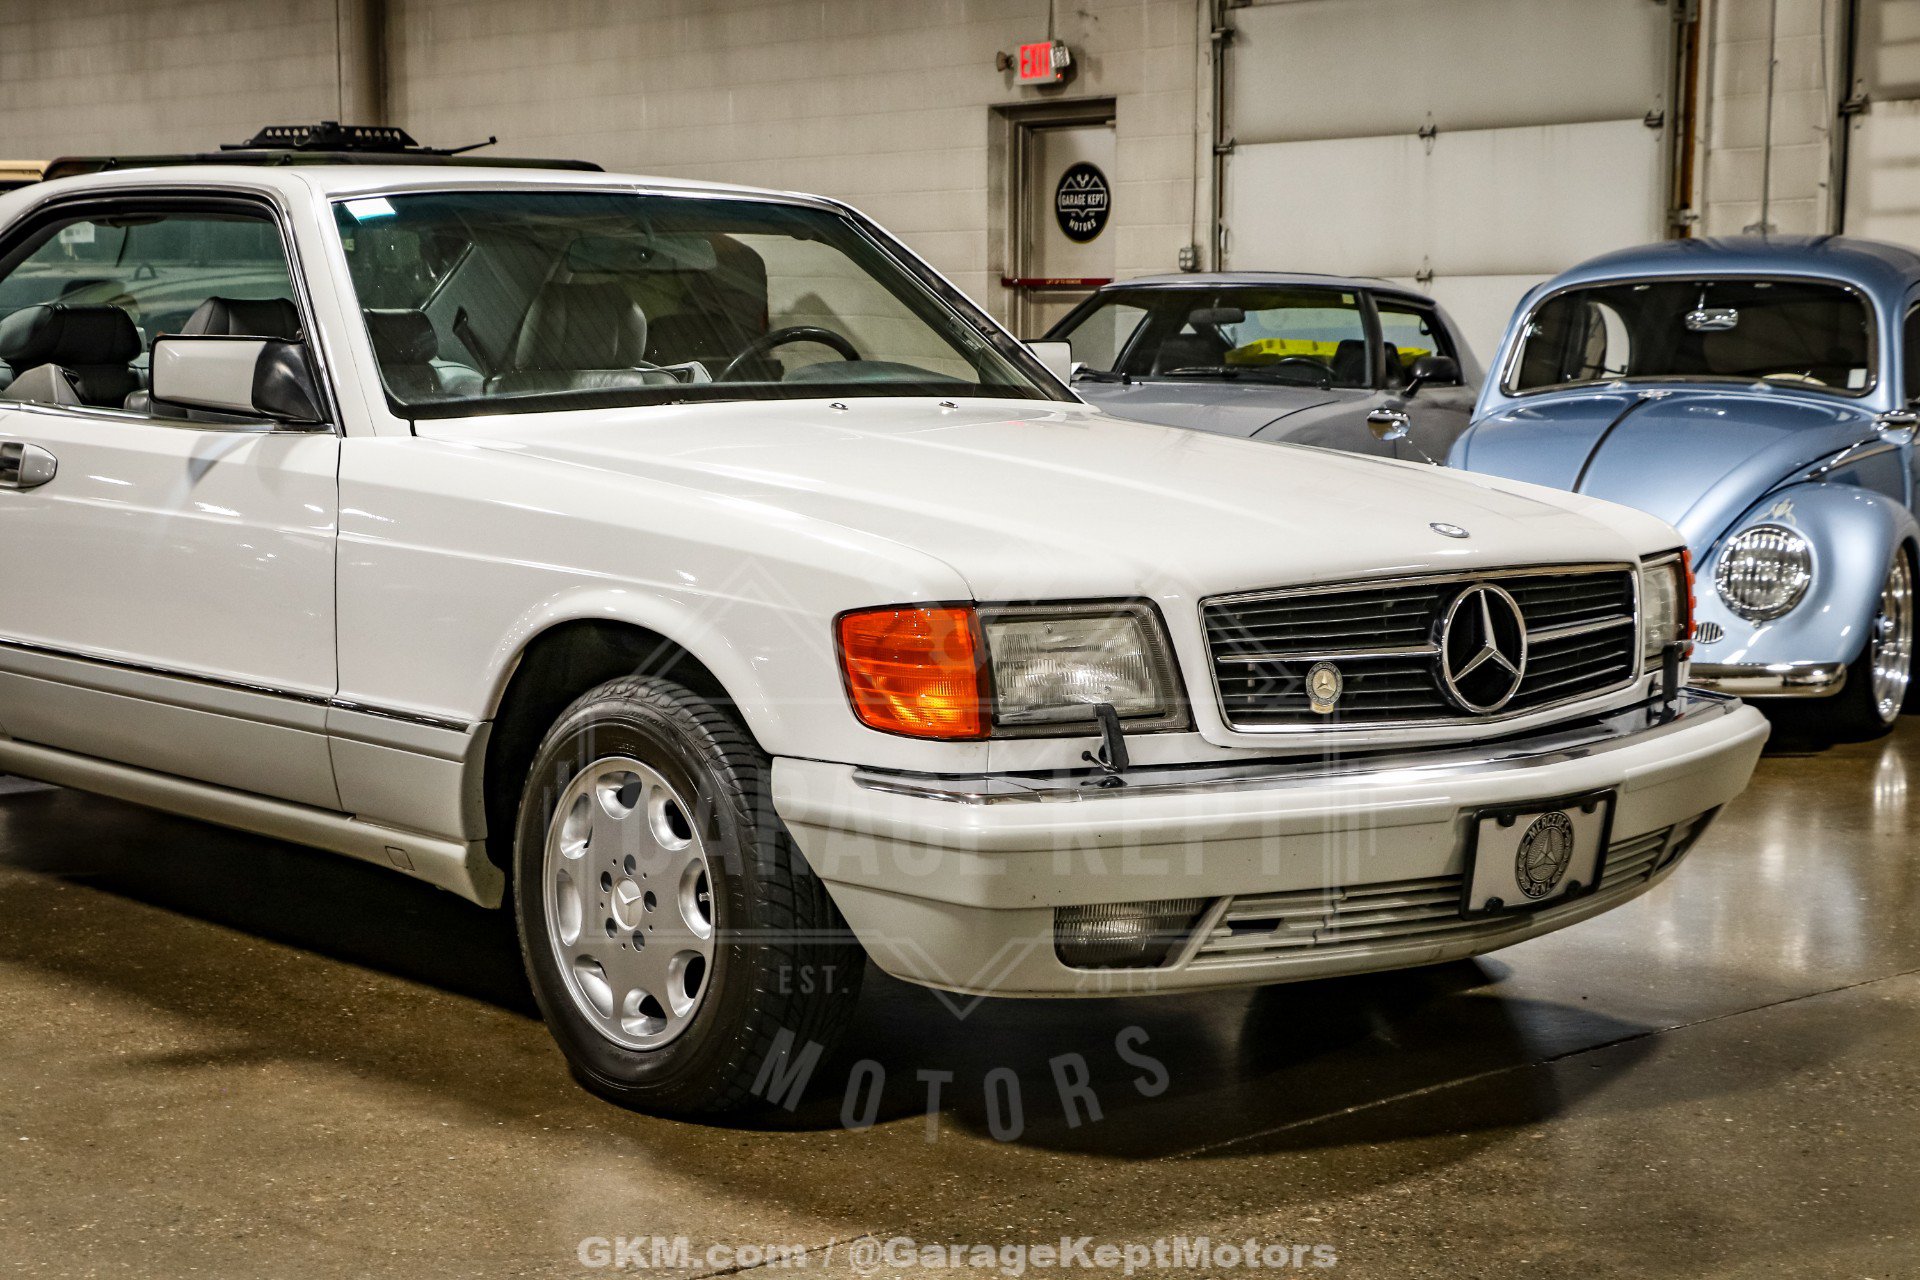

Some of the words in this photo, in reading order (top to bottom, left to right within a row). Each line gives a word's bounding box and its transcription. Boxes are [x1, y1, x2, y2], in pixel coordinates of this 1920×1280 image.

[1020, 42, 1051, 79] EXIT
[1061, 194, 1086, 206] GARAGE
[1087, 193, 1104, 205] KEPT
[1069, 218, 1097, 232] MOTORS
